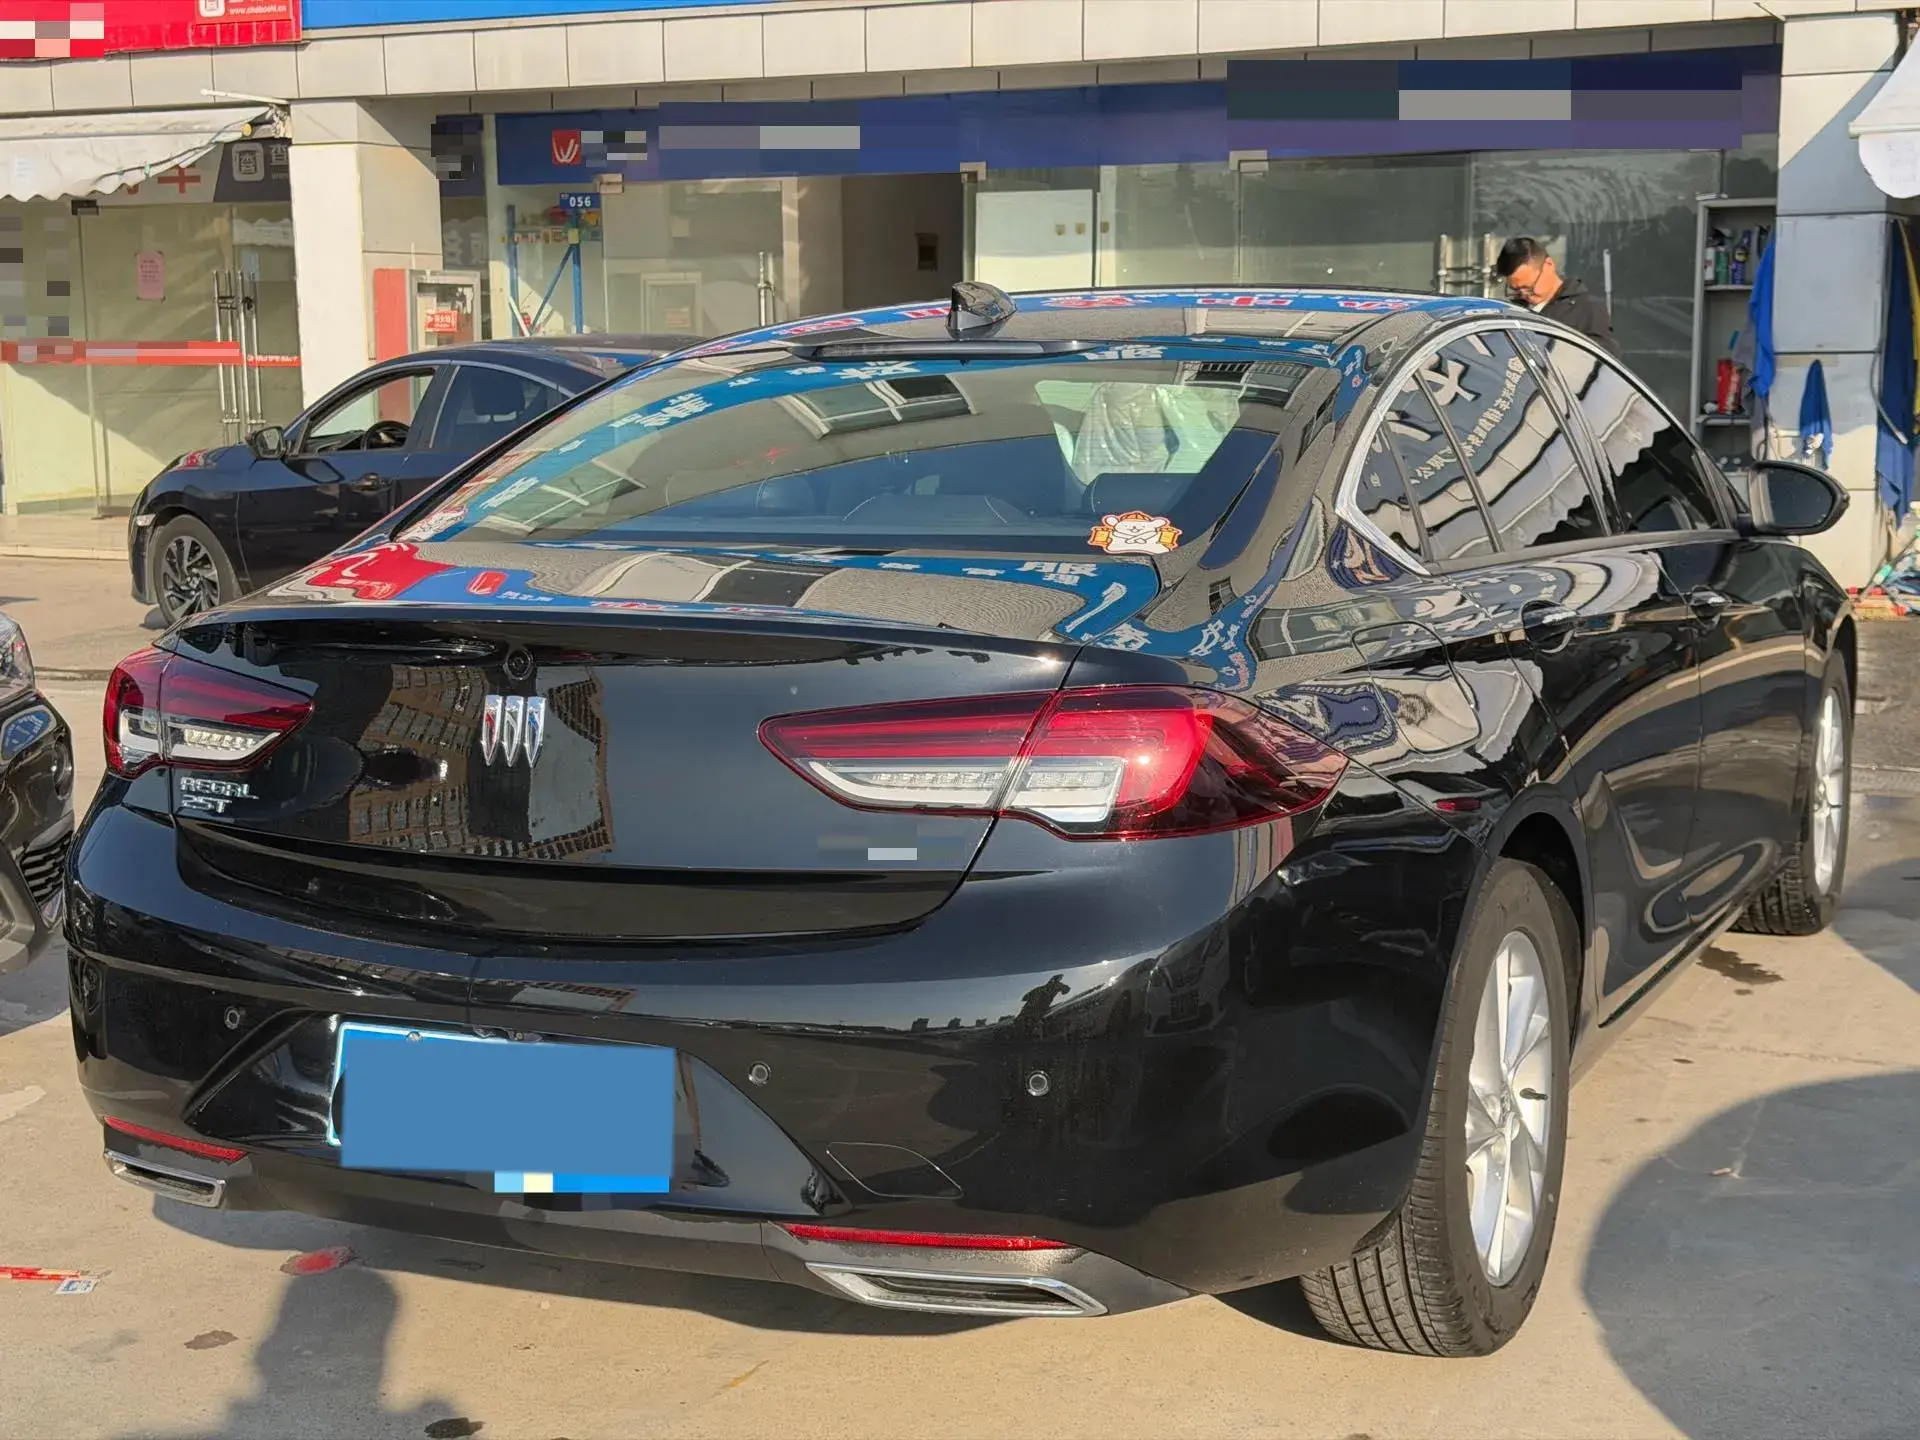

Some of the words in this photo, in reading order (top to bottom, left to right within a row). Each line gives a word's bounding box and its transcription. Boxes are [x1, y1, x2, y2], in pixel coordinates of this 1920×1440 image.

[569, 195, 592, 208] 056
[180, 776, 259, 799] REGAL
[181, 794, 233, 813] 25T
